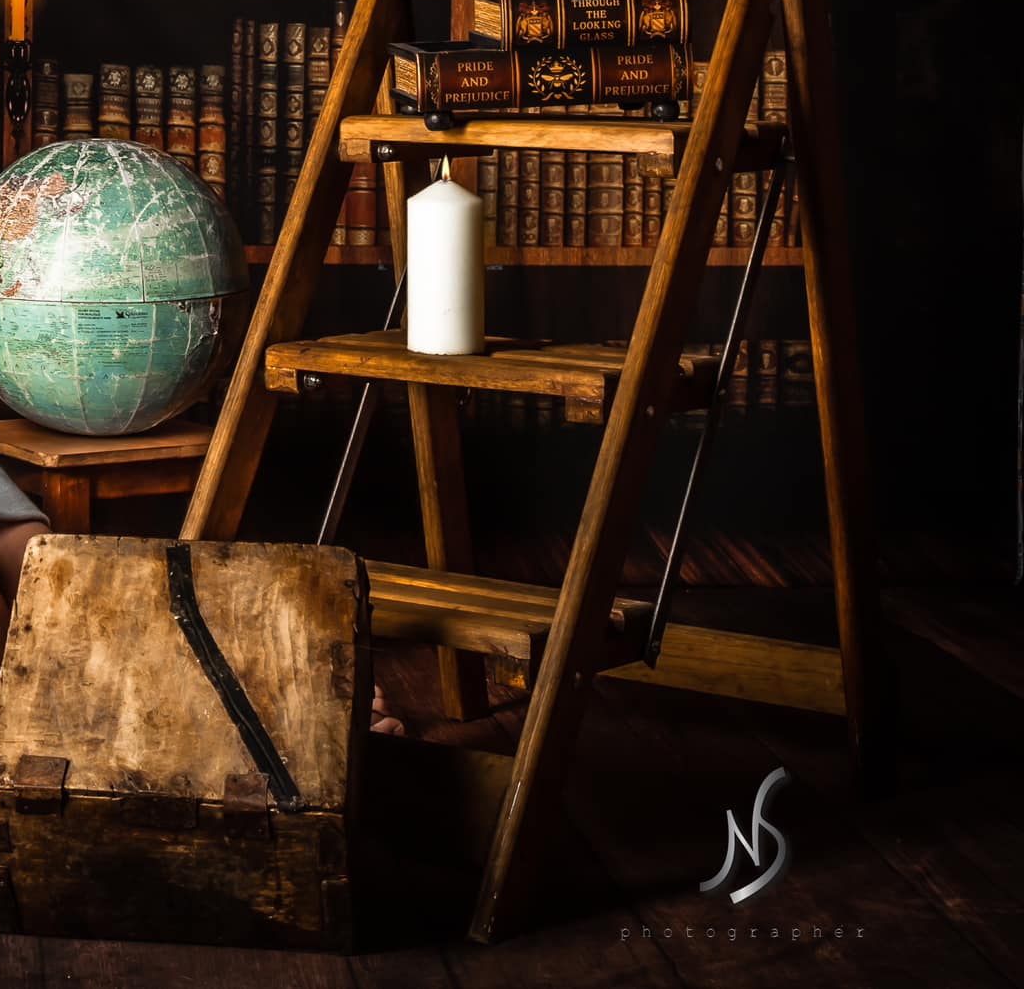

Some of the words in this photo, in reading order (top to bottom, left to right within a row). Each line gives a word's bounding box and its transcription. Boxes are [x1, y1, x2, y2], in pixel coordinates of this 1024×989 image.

[586, 9, 608, 19] THE
[573, 20, 621, 30] LOOKING
[579, 31, 615, 41] GLASS
[617, 54, 654, 65] PRIDE
[457, 61, 494, 72] PRIDE
[620, 69, 649, 81] AND
[460, 76, 489, 88] AND
[605, 84, 670, 96] PREJUDICE
[445, 91, 510, 104] PREJUDICE
